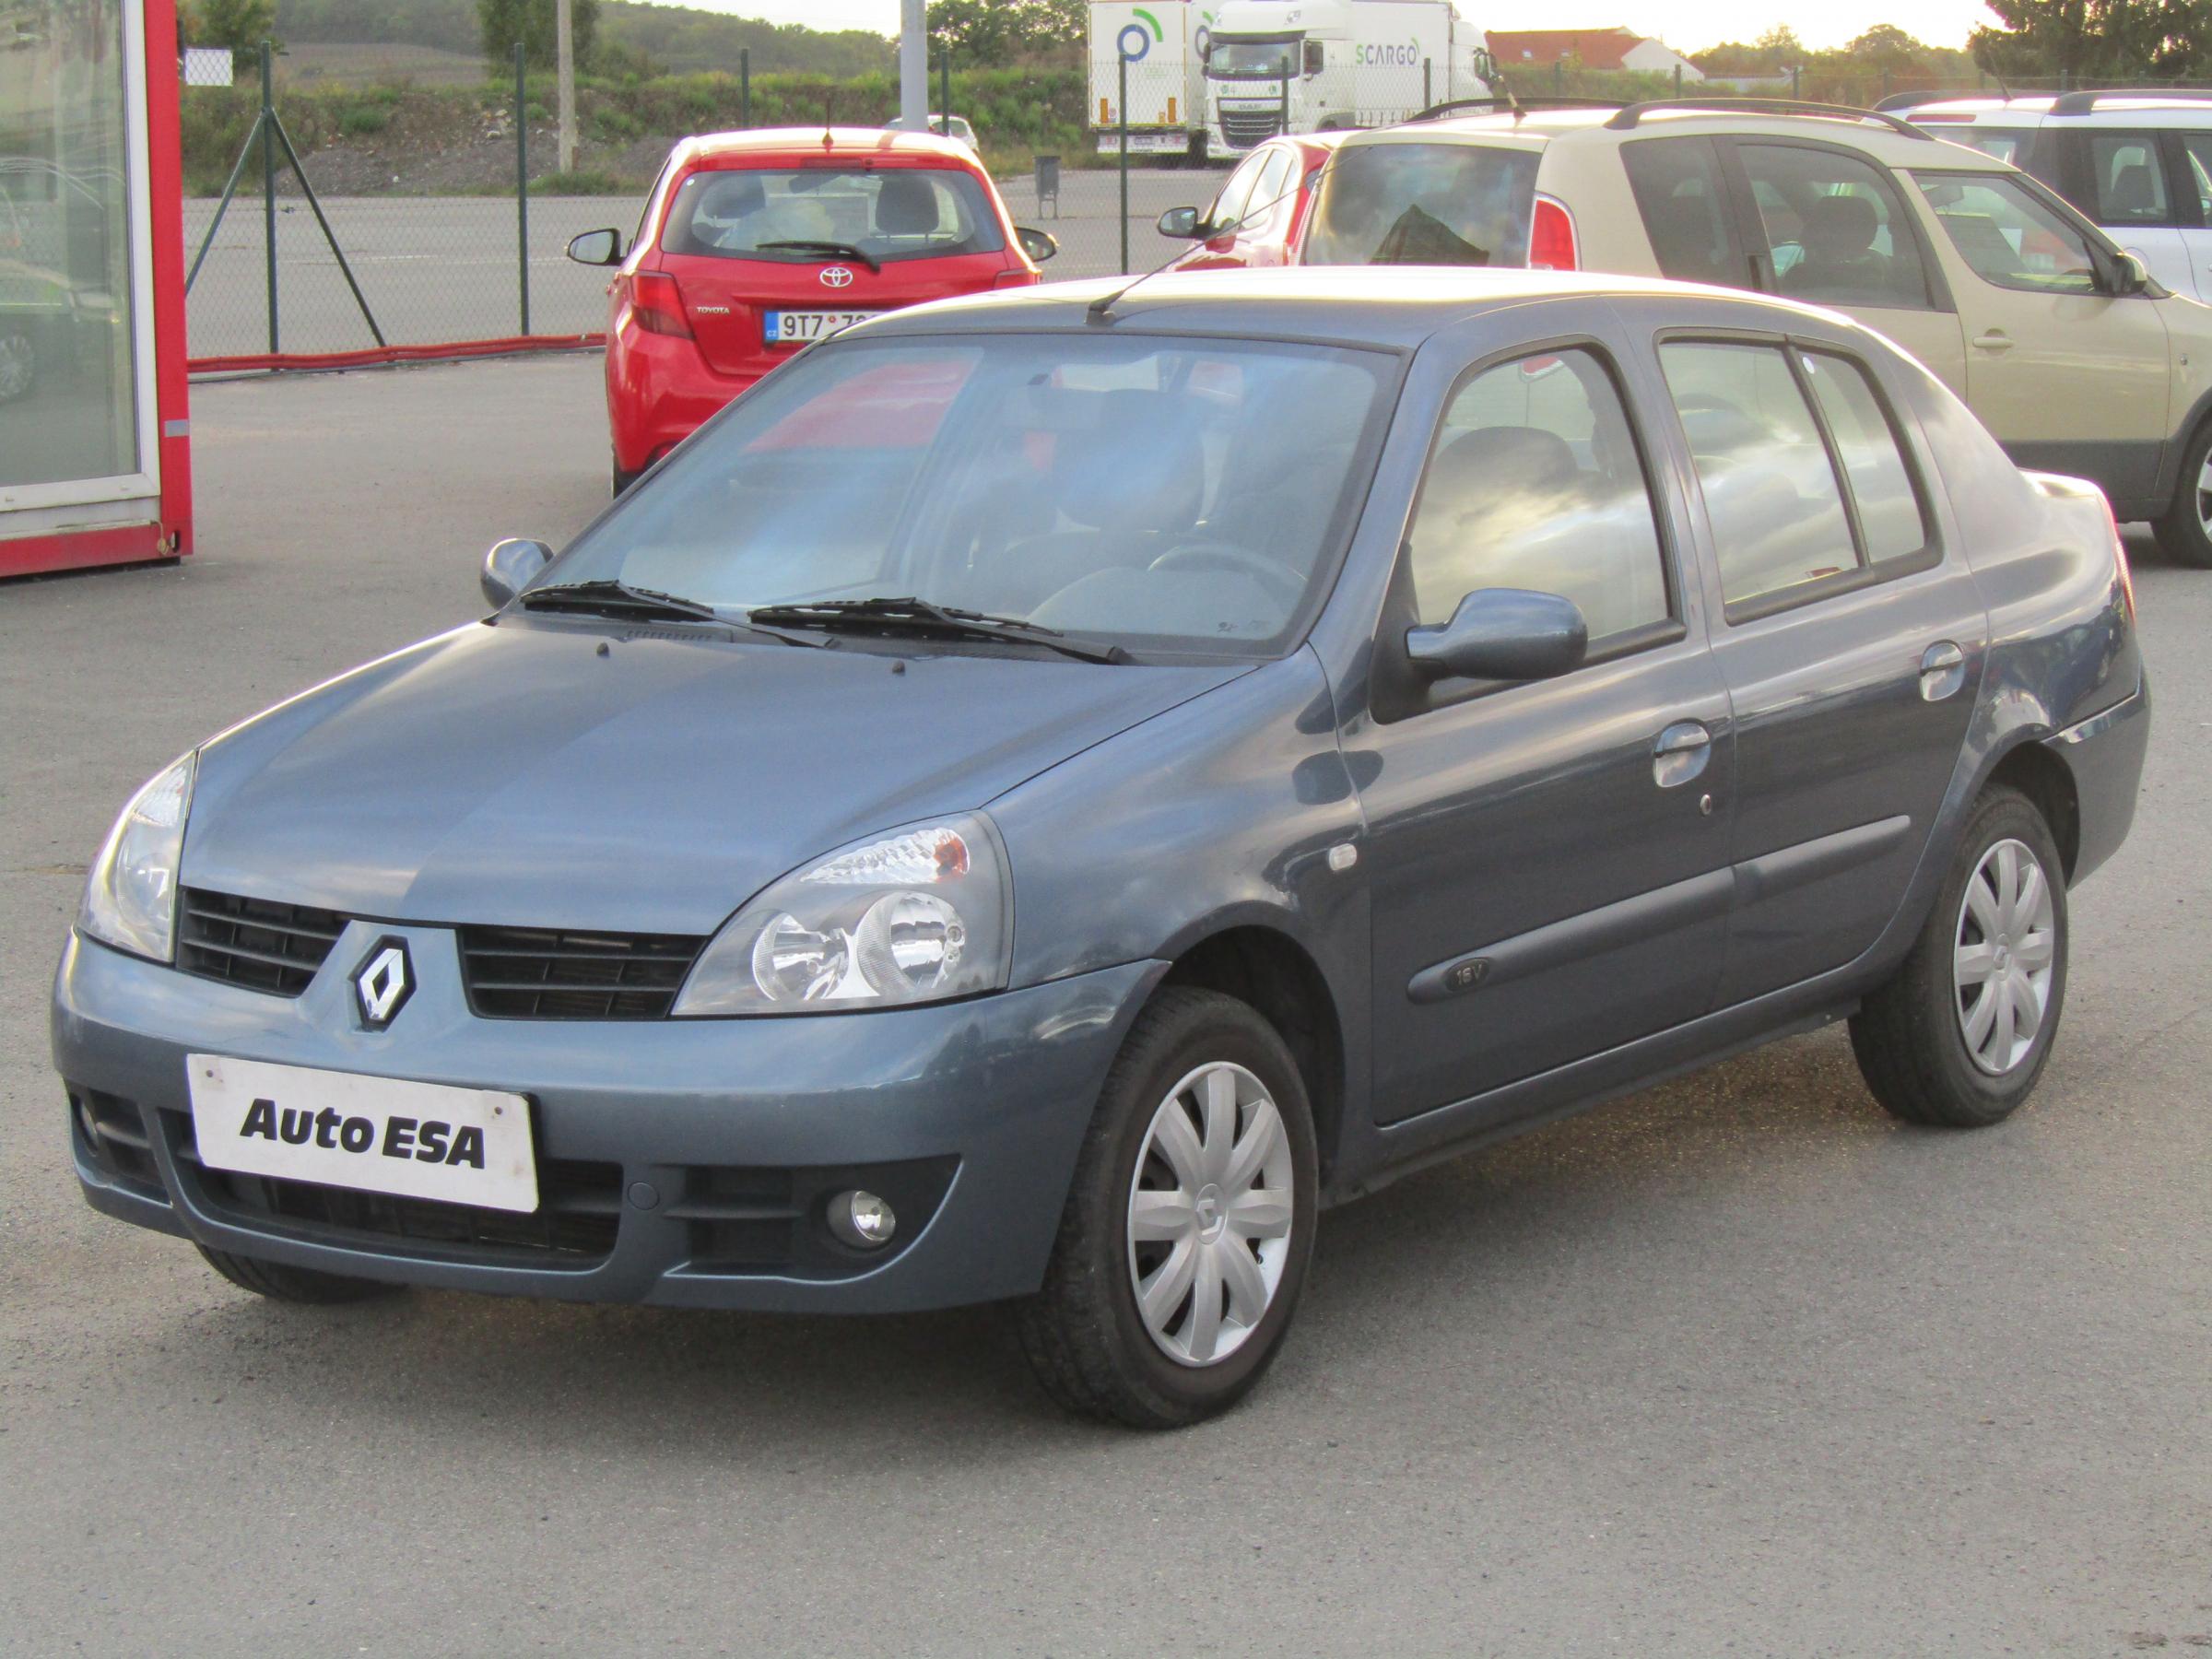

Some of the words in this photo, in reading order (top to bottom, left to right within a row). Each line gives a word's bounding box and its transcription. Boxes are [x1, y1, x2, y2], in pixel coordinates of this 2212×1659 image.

[1356, 43, 1417, 65] SCARGO
[696, 306, 730, 314] TOYOTA
[783, 314, 823, 336] 9T7
[240, 1098, 375, 1153] Auto
[382, 1115, 485, 1170] ESA
